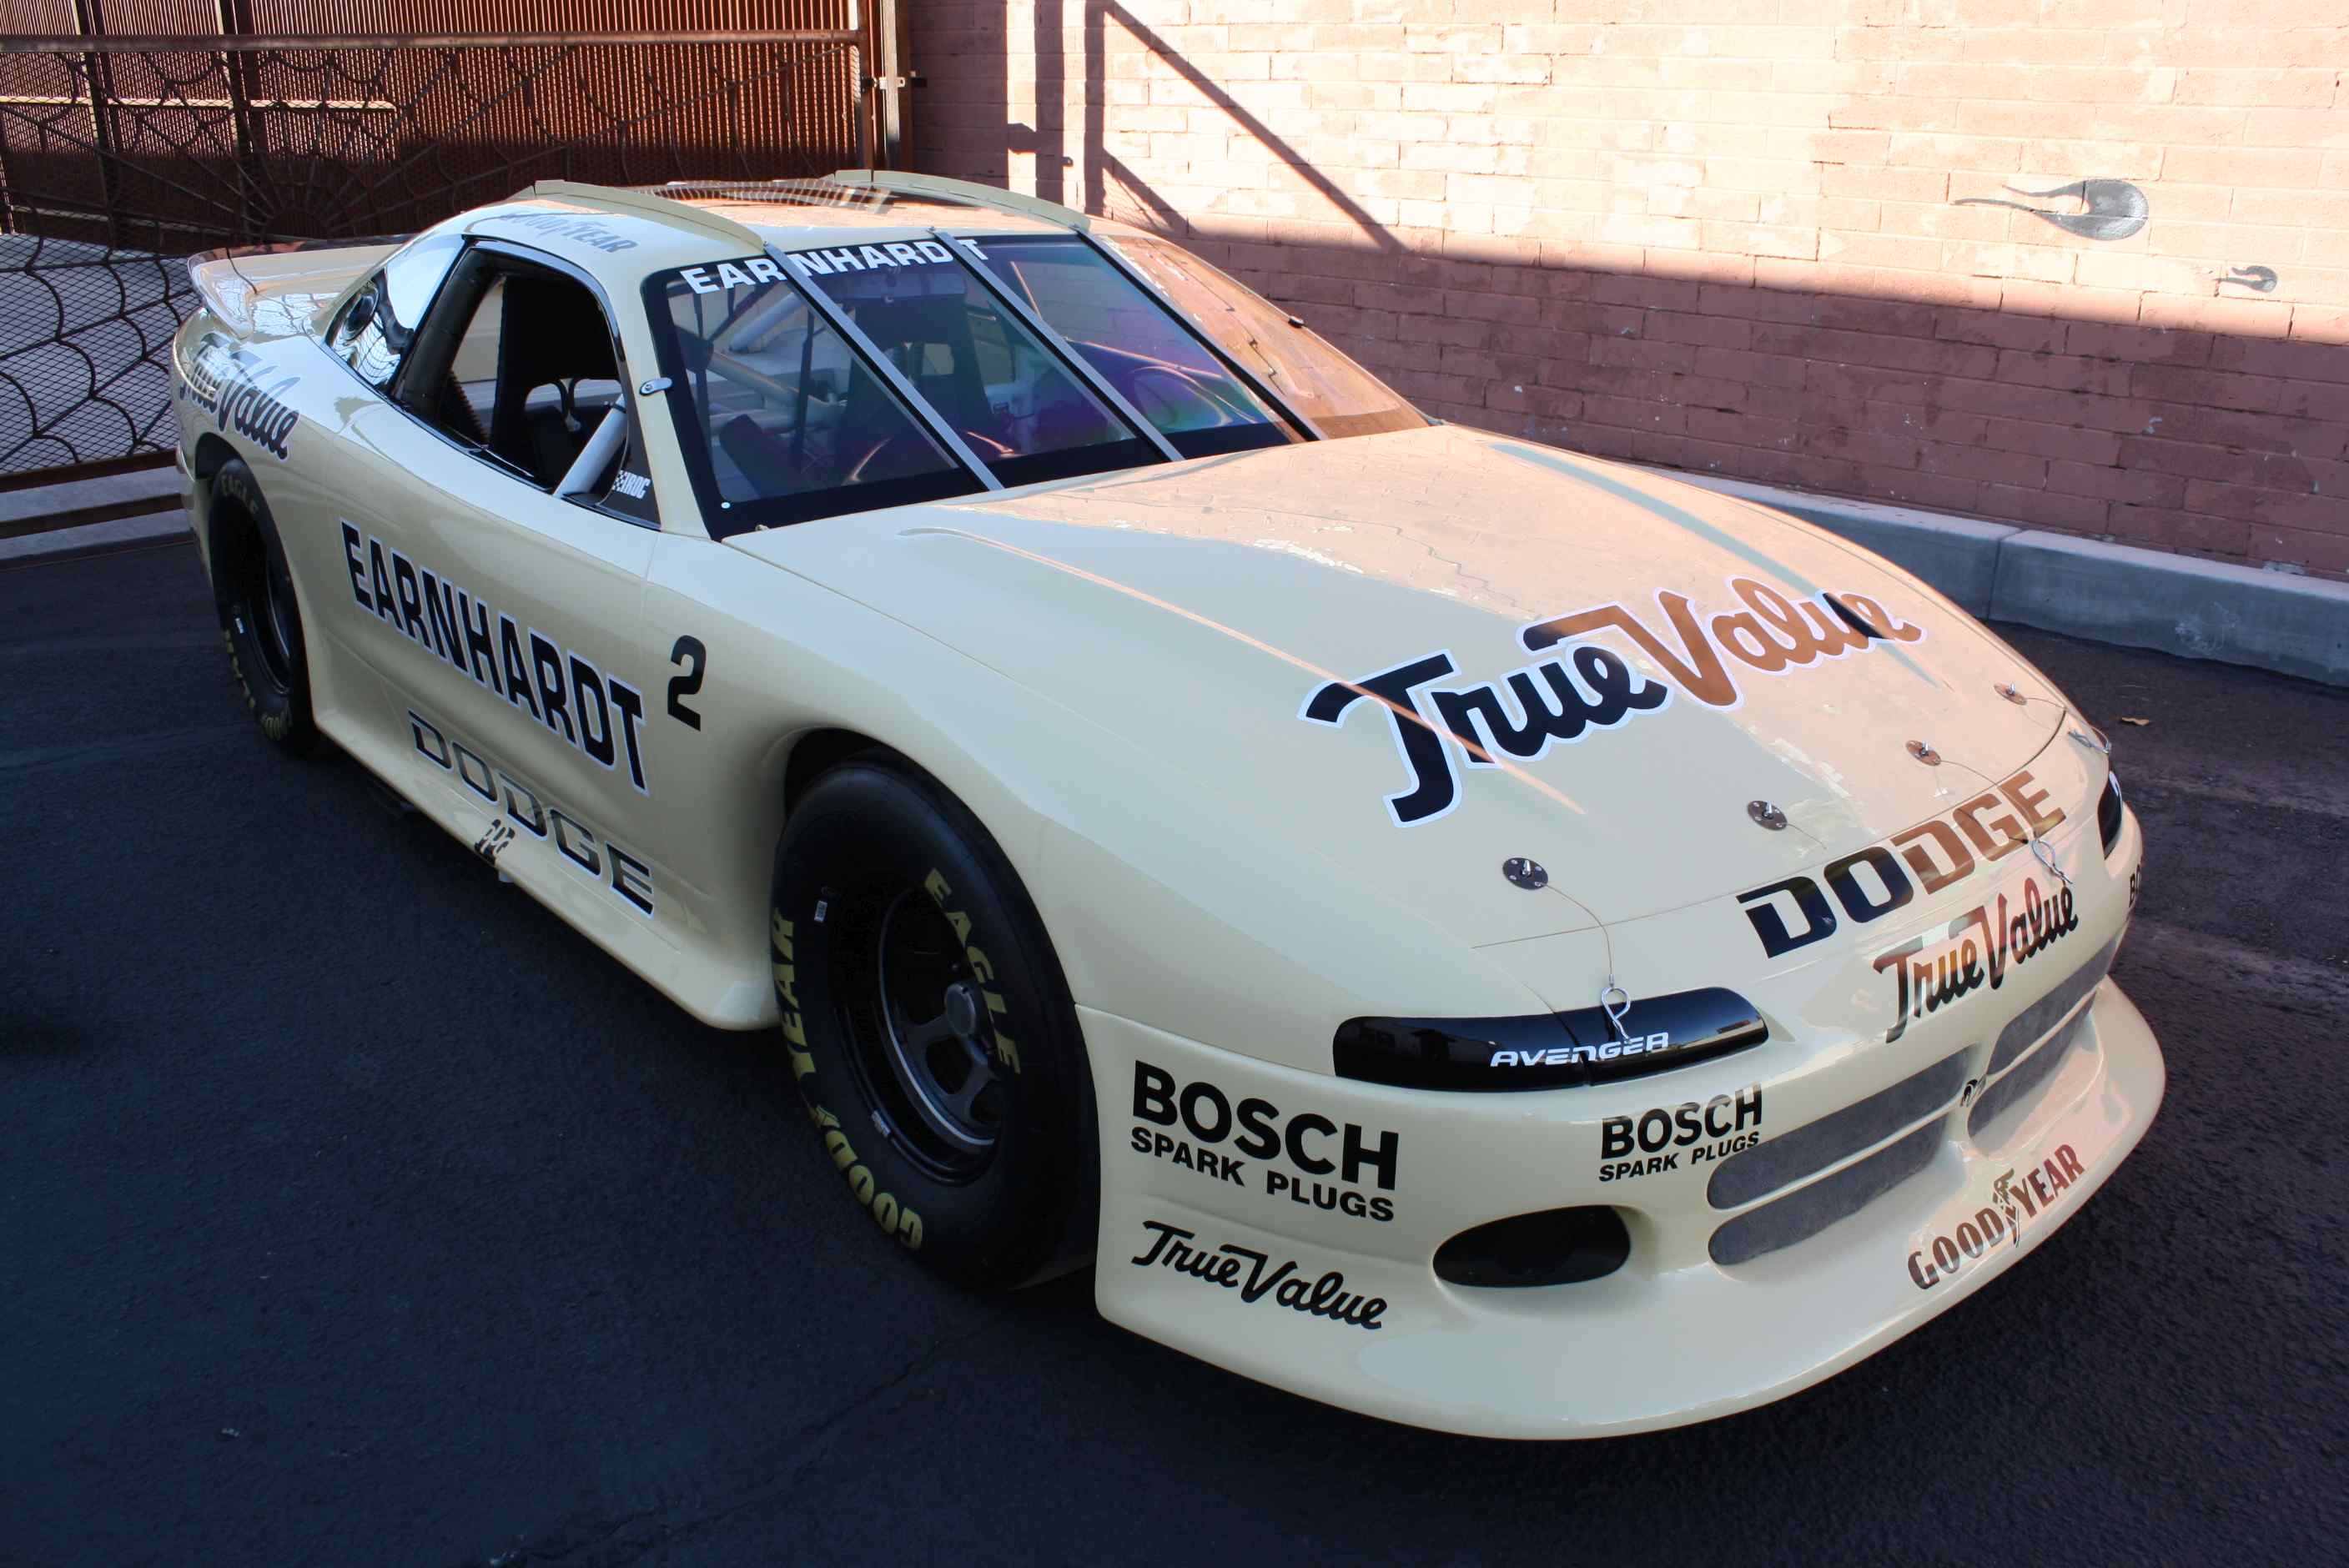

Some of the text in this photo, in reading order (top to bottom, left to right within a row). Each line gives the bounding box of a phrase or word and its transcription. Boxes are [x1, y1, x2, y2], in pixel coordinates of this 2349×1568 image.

[680, 239, 988, 294] EARNHARDT
[620, 472, 651, 499] IROC
[340, 517, 649, 797] EARNHARDT
[667, 635, 707, 731] 2
[408, 707, 654, 917] DODGE
[1736, 771, 2066, 958] DODGE
[925, 868, 1021, 1074] EAGLE
[1490, 1032, 1669, 1068] AVENGER
[1133, 1059, 1399, 1191] BOSCH
[1598, 1131, 1760, 1182] SPARK PLUGS
[1602, 1081, 1763, 1159] BOSCH
[1130, 1127, 1394, 1222] SPARK PLUGS
